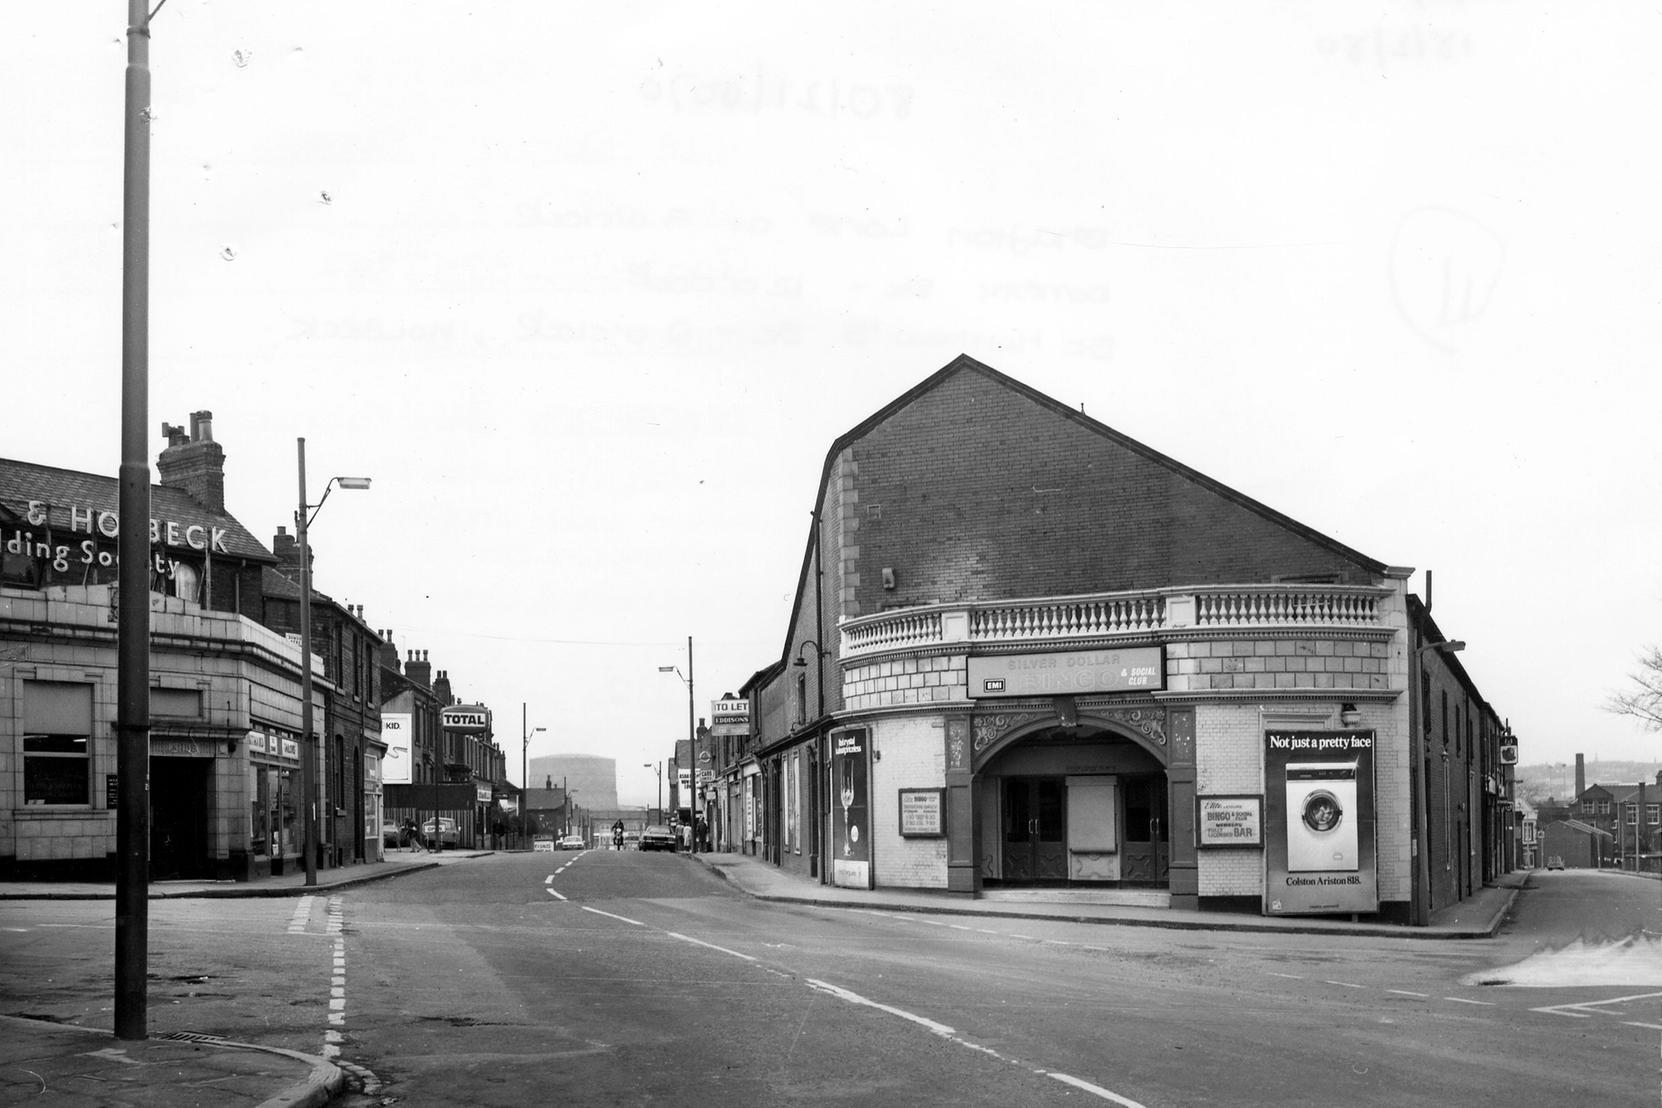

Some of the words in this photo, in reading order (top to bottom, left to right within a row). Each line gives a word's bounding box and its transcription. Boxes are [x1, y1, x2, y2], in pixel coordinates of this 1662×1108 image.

[27, 500, 47, 526] &
[71, 504, 229, 553] HOBECK
[0, 529, 70, 572] ding
[81, 540, 180, 580] Soty
[1007, 659, 1057, 670] SILVER
[1067, 655, 1120, 667] DOLLAR
[1130, 667, 1157, 676] SOCIAL
[987, 682, 1002, 690] EMI
[1128, 676, 1148, 686] CLUB
[716, 703, 728, 711] TO
[731, 703, 748, 711] LET
[444, 714, 485, 725] TOTAL
[1270, 735, 1290, 748] Not
[1291, 736, 1310, 750] just
[1311, 739, 1318, 748] a
[1319, 736, 1350, 750] pretty
[1351, 735, 1372, 748] face
[1207, 811, 1231, 821] BINGO
[1233, 827, 1253, 838] BAR
[1286, 876, 1316, 886] Colston
[1317, 876, 1347, 886] Ariston
